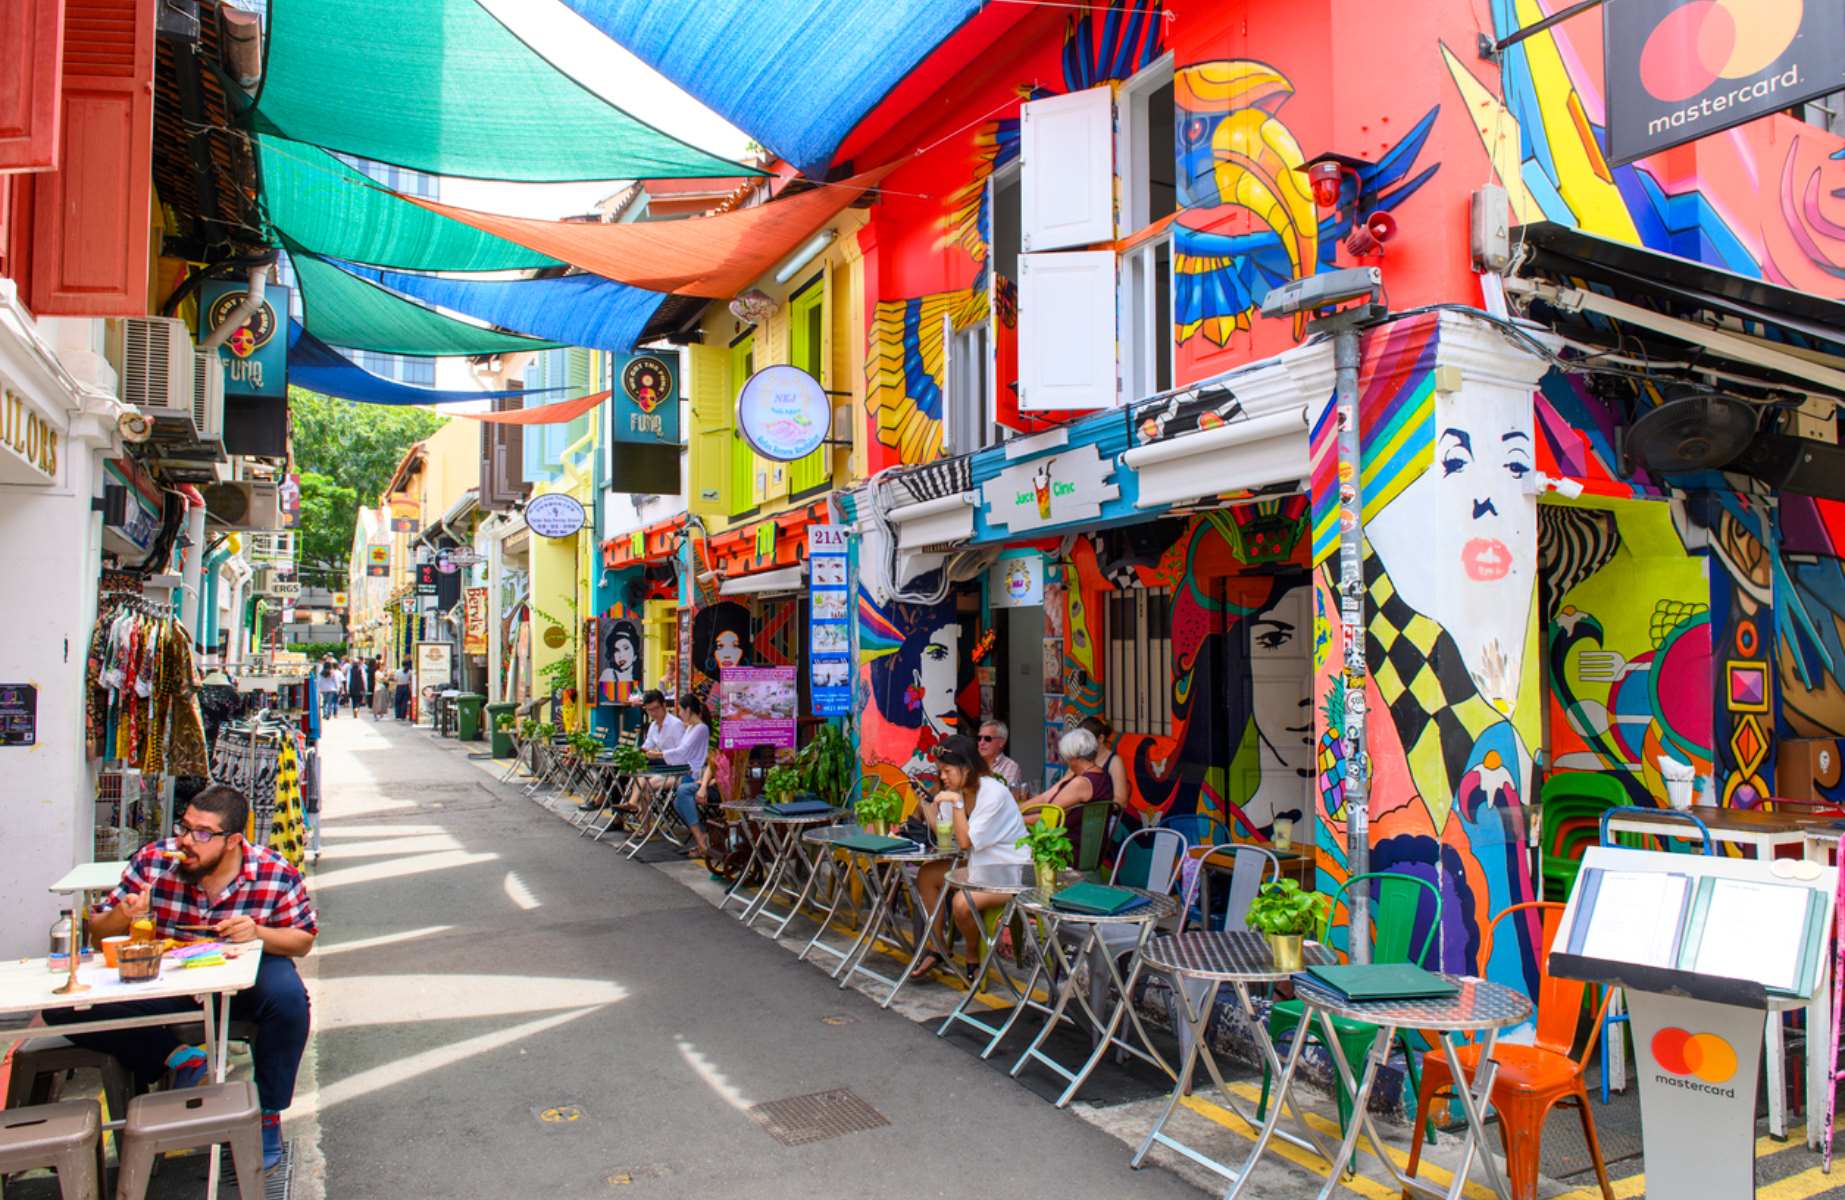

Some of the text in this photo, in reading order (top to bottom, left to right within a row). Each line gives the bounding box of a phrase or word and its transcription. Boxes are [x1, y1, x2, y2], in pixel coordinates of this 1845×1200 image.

[0, 382, 57, 477] ILORS
[814, 530, 843, 545] 21A
[1655, 1074, 1735, 1099] mastercard
